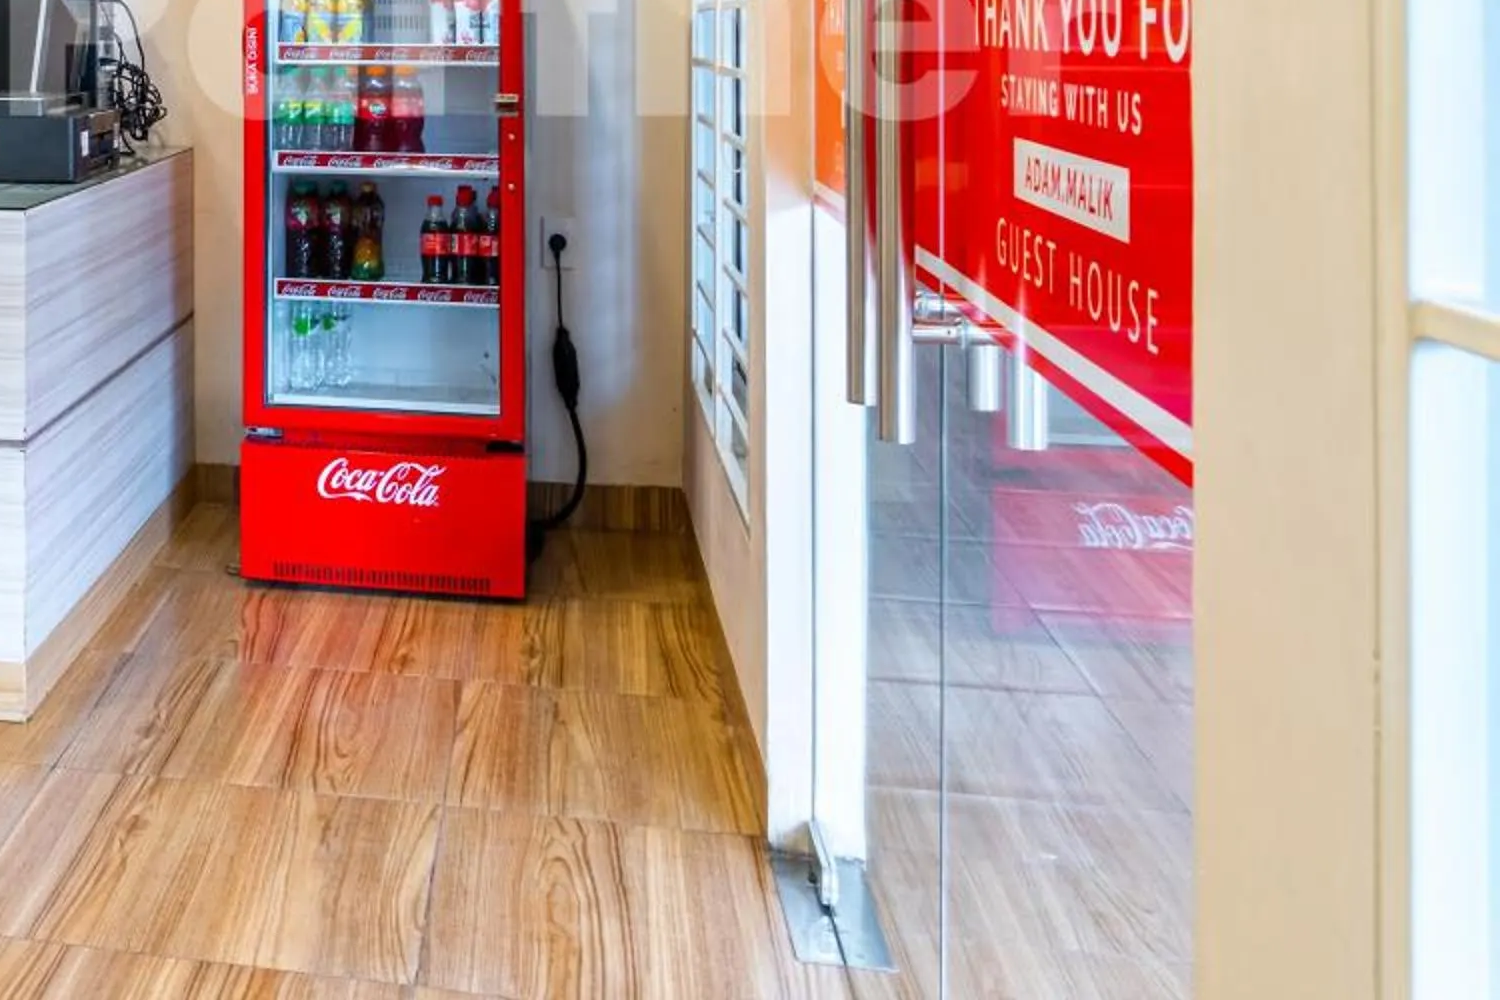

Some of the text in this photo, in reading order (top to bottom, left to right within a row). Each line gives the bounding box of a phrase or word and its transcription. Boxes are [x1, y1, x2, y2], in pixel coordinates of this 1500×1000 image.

[1001, 74, 1143, 136] STAYING WITH US
[996, 217, 1160, 355] GUEST HOUSE
